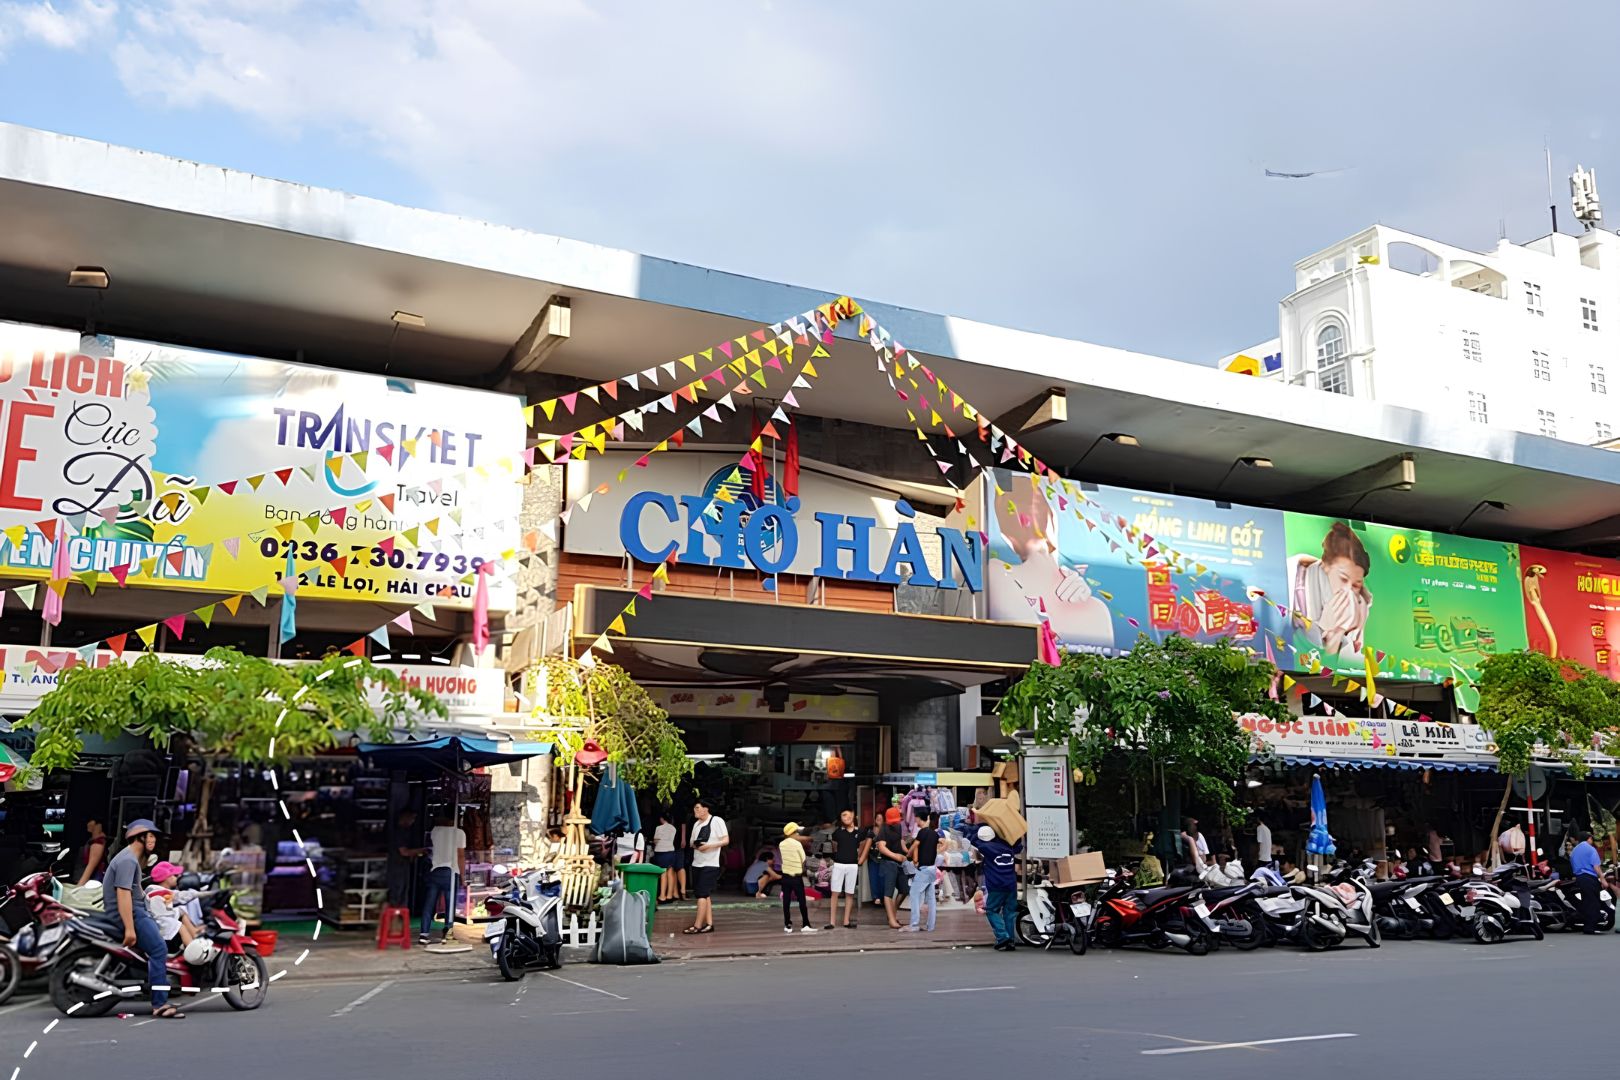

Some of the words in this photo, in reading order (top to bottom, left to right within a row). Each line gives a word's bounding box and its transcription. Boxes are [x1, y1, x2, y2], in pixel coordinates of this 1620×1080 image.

[29, 351, 127, 398] LỊCH
[64, 400, 140, 450] Cực
[0, 389, 55, 511] È
[265, 504, 302, 522] Bạn
[620, 491, 801, 591] CHỢ
[814, 498, 984, 593] HÀN
[1231, 520, 1264, 548] CỐT
[12, 673, 58, 685] TAN
[1241, 717, 1304, 739] NGỌC
[1425, 725, 1457, 739] KIM
